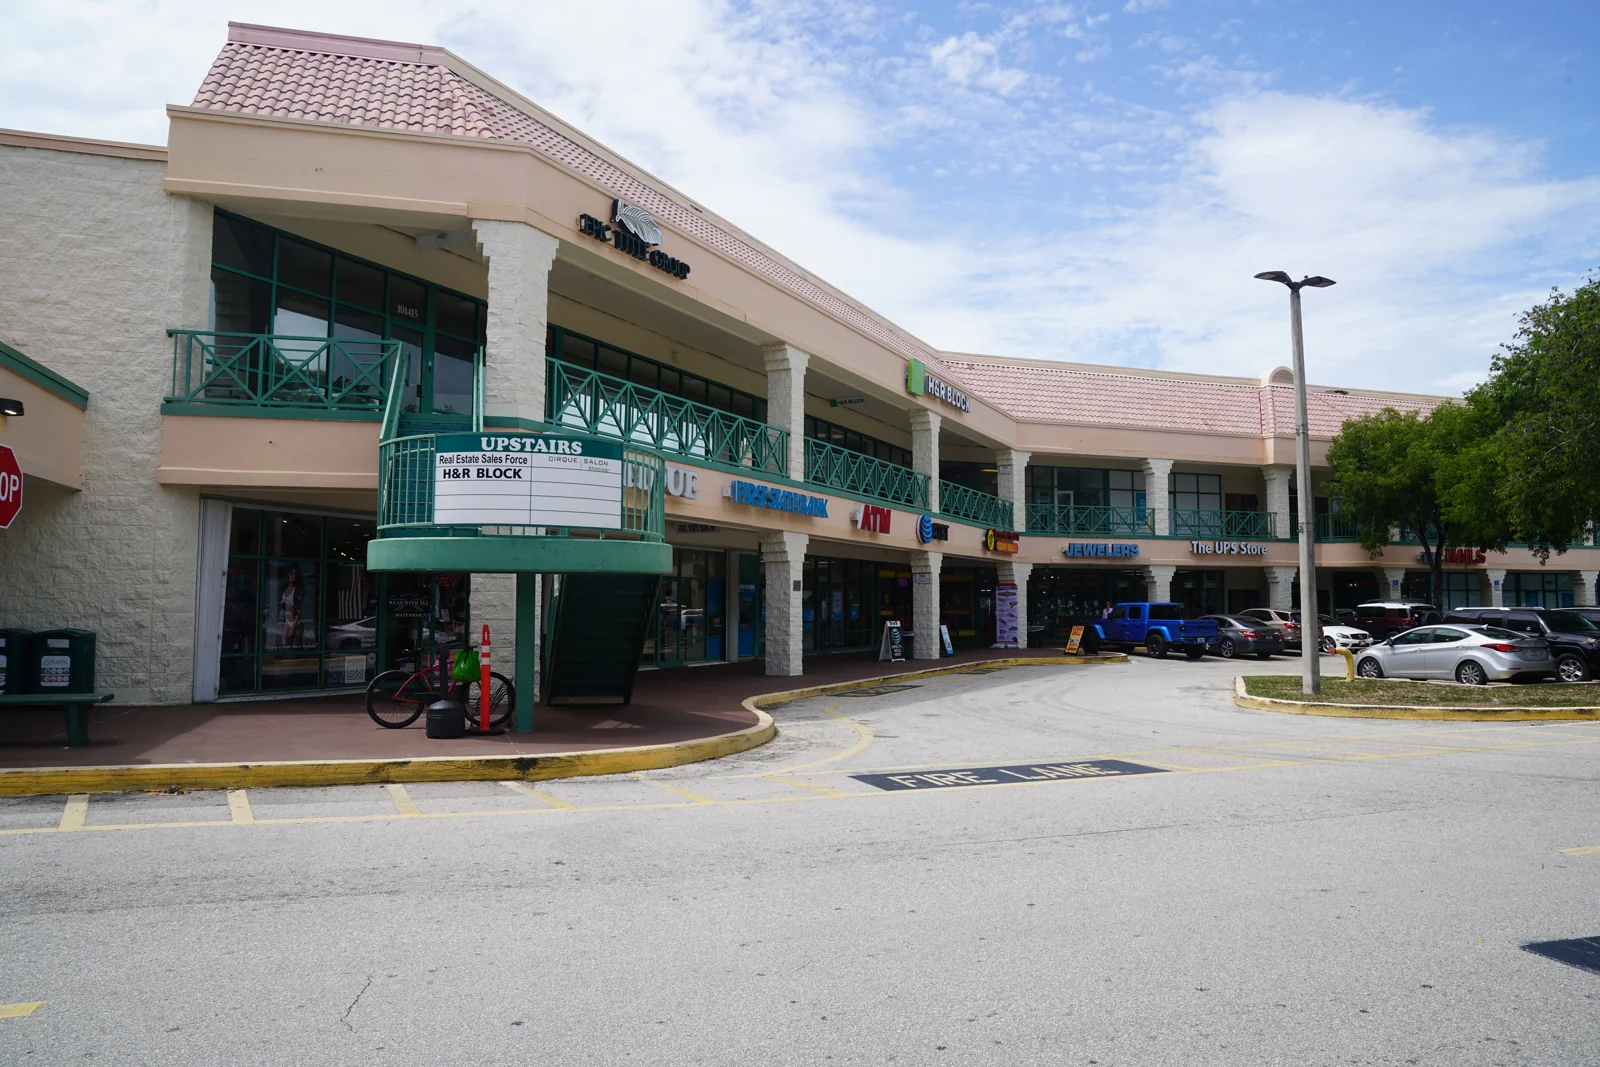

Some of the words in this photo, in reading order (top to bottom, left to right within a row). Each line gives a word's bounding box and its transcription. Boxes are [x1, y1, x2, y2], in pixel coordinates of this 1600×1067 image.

[580, 213, 613, 243] EPIC
[649, 249, 691, 280] GROUP
[928, 375, 946, 400] H&R
[946, 385, 972, 413] BLOCK
[480, 436, 583, 455] UPSTAIRS
[439, 454, 455, 465] Real
[456, 454, 480, 464] Estate
[481, 453, 503, 464] Sales
[505, 454, 528, 465] Force
[548, 456, 578, 464] CIRQUE
[583, 458, 609, 466] SALON
[443, 468, 471, 479] H&R
[476, 468, 522, 479] BLOCK
[735, 480, 769, 508] FIRST
[768, 487, 801, 513] STATE
[799, 494, 829, 518] BANK
[857, 504, 891, 534] ATM
[1065, 543, 1140, 558] JEWELERS
[1191, 540, 1213, 554] The
[1215, 541, 1238, 554] UPS
[1240, 541, 1268, 555] Store
[1444, 548, 1487, 564] NAILS
[887, 771, 999, 789] FIRE
[998, 763, 1123, 780] LANE
